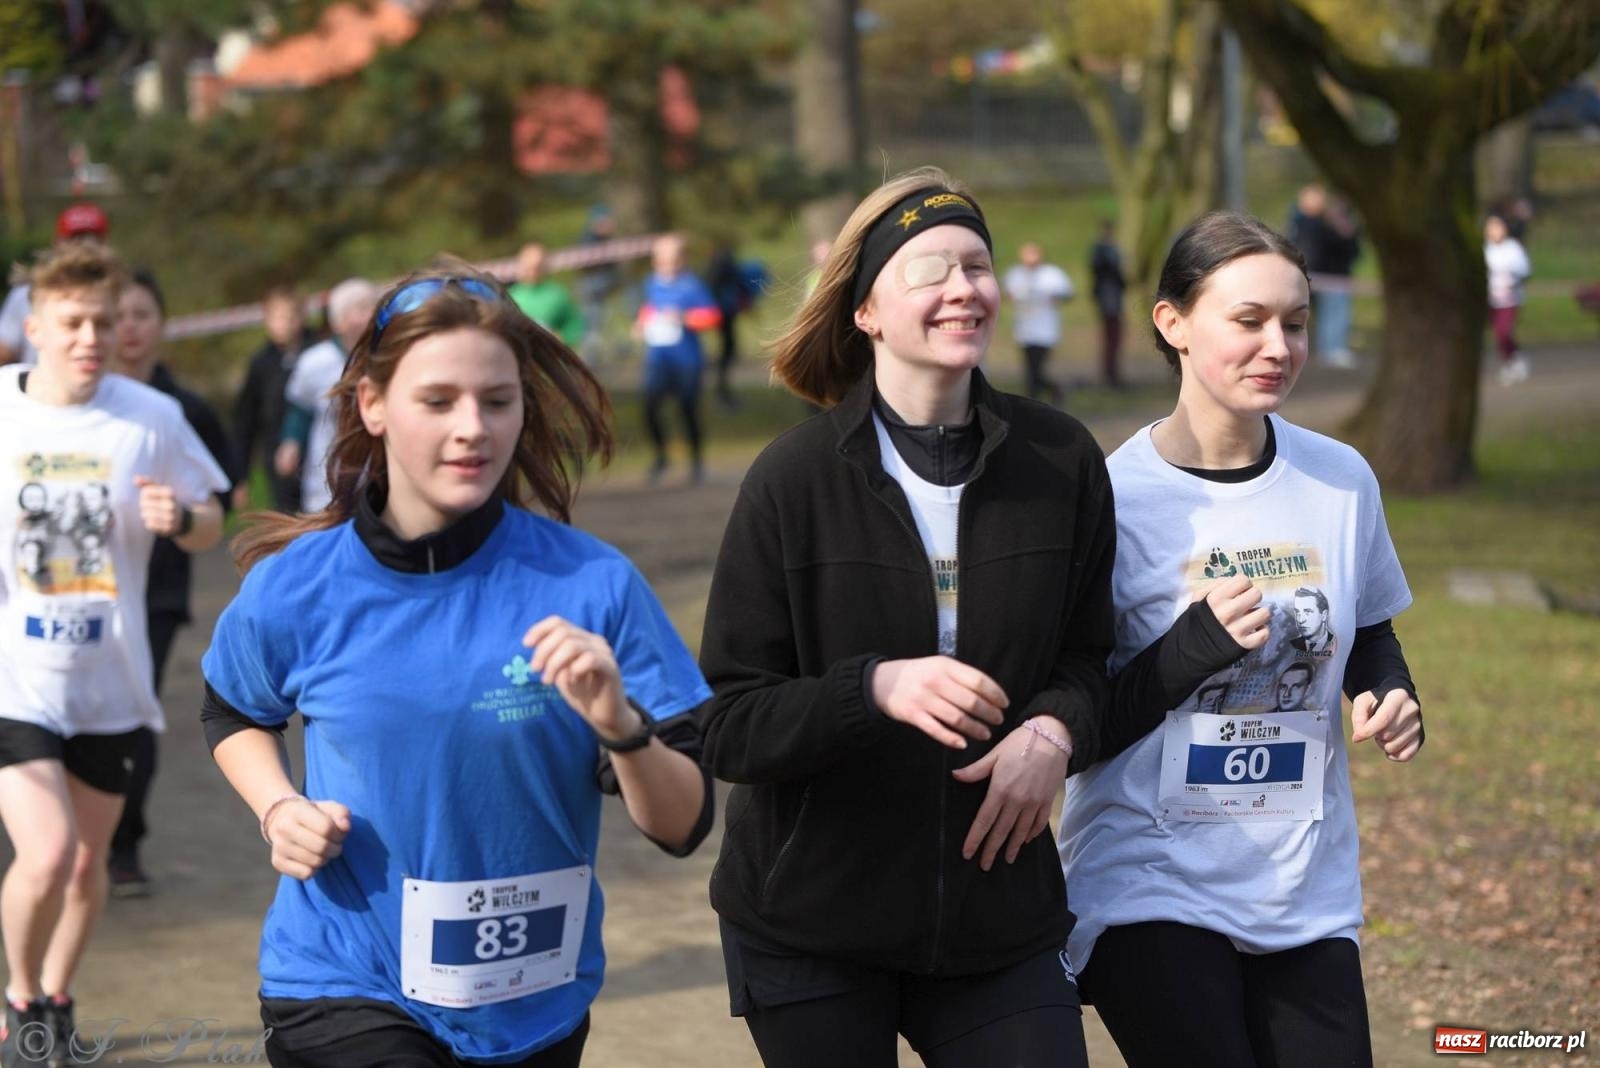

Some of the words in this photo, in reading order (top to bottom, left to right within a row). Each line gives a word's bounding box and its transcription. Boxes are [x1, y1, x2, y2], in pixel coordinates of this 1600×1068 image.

[1236, 548, 1272, 562] TROPEM
[935, 560, 959, 571] TROP
[1241, 555, 1308, 579] WILCZYM
[40, 617, 89, 644] 120
[1240, 719, 1263, 728] TROPEM
[1240, 726, 1281, 739] WILCZYM
[1223, 746, 1271, 782] 60
[492, 889, 540, 909] WILCZYM
[474, 914, 529, 960] 83
